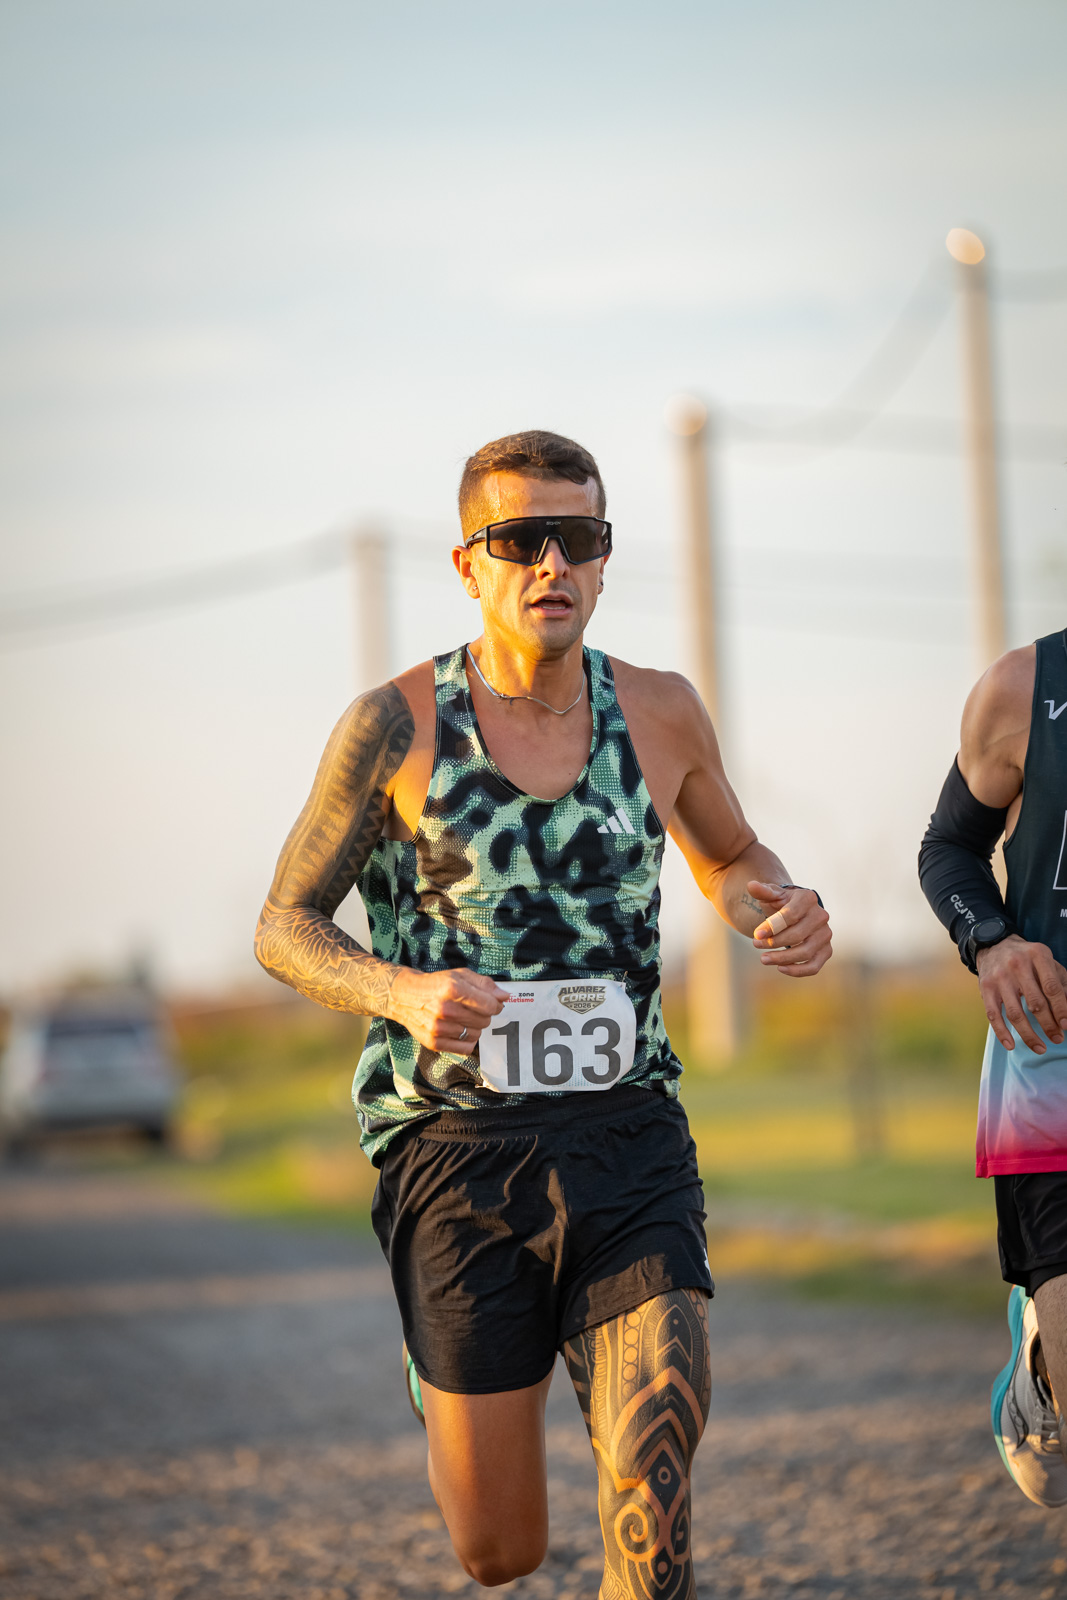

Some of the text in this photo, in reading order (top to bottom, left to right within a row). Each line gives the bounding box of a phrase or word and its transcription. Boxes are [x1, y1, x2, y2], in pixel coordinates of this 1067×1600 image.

[559, 985, 606, 996] ALVAREZ
[561, 993, 606, 1003] CORRE
[492, 1017, 621, 1087] 163
